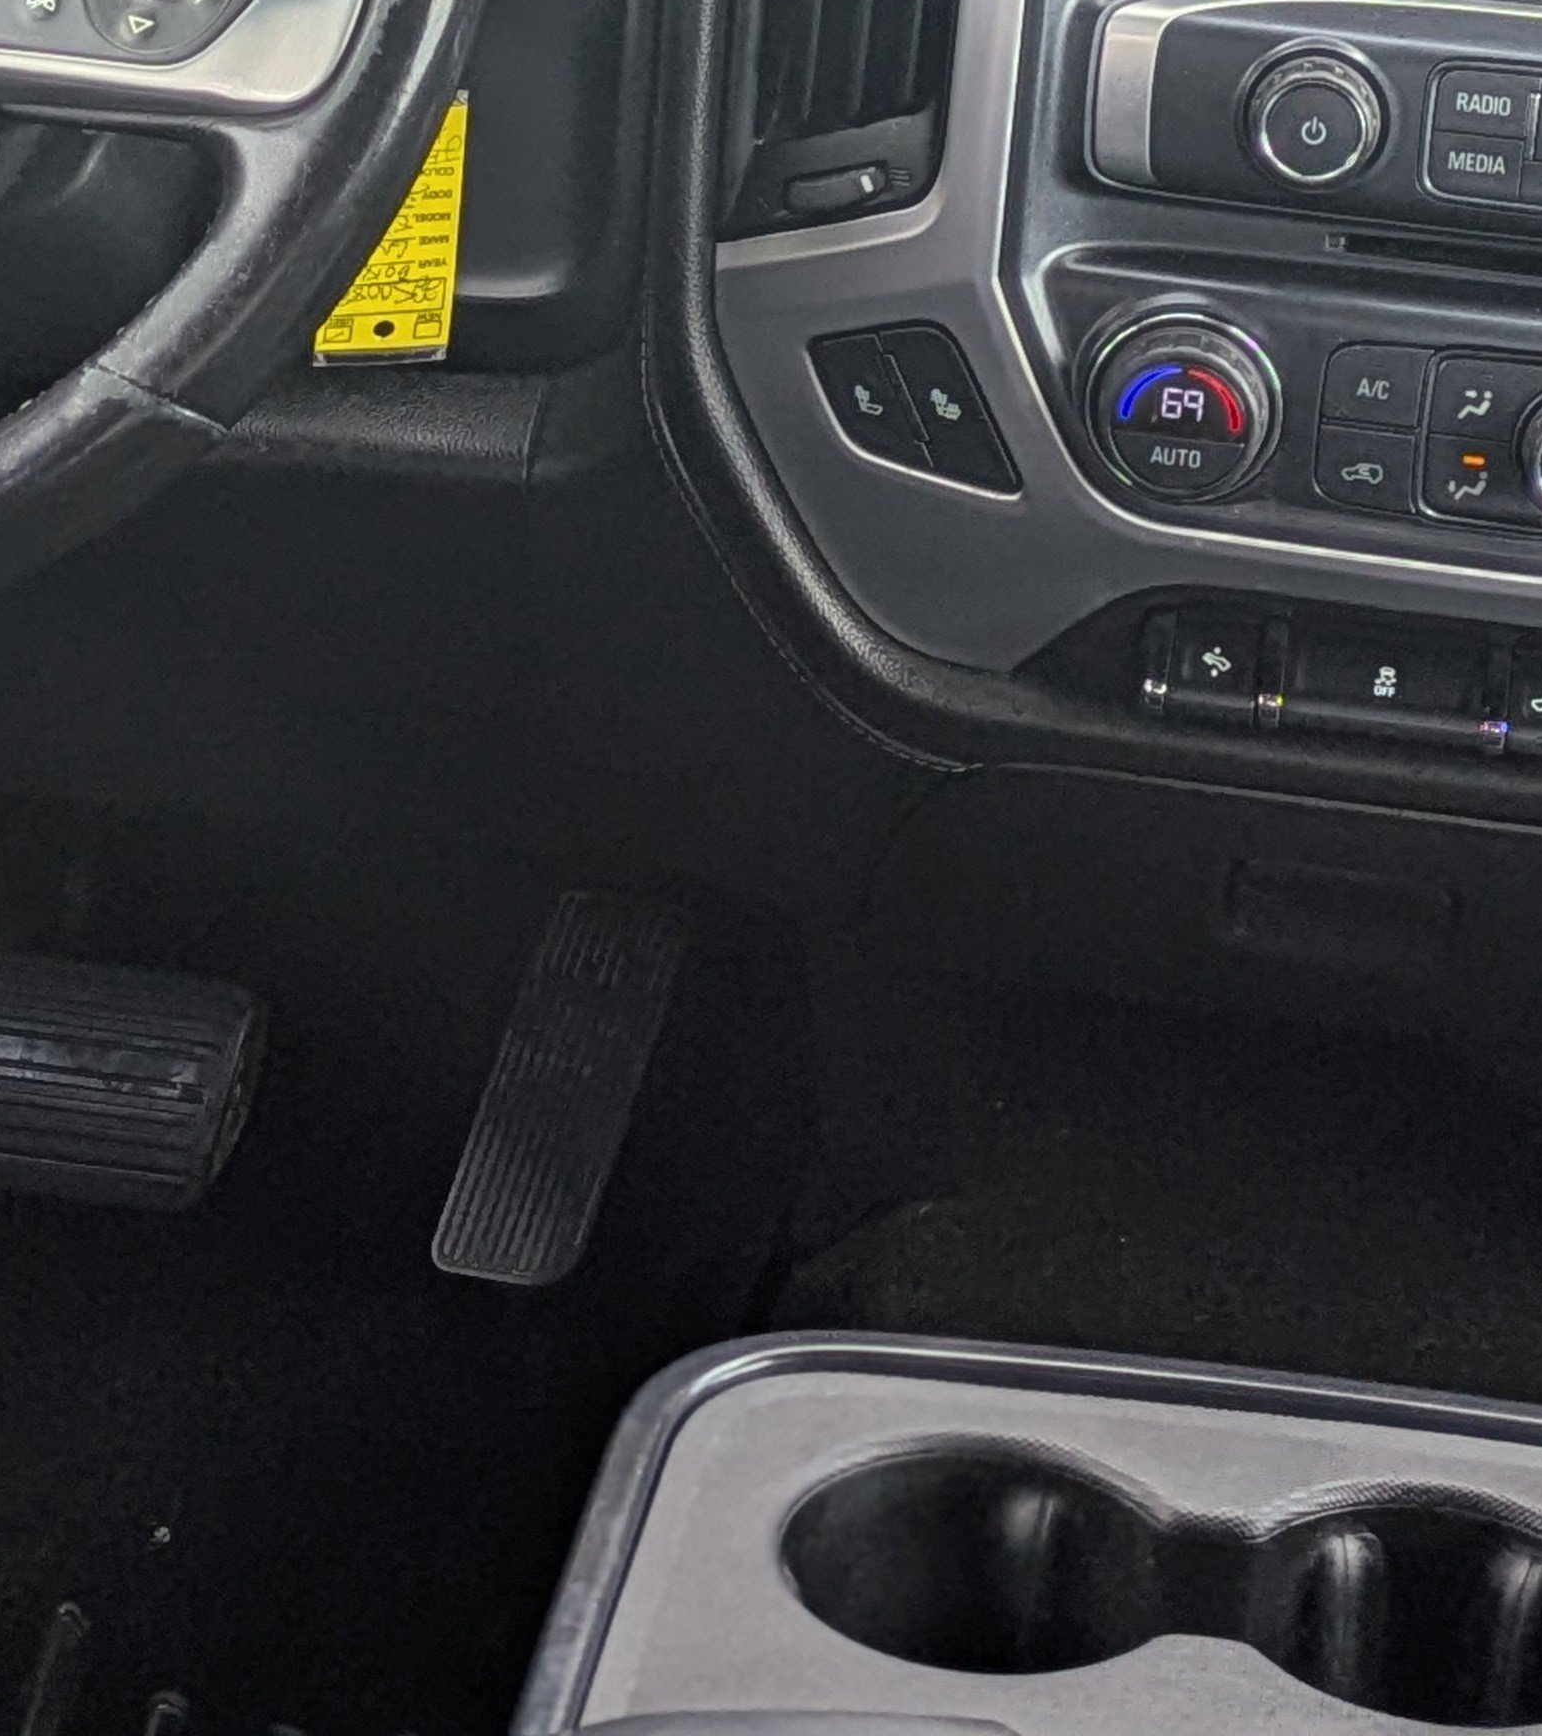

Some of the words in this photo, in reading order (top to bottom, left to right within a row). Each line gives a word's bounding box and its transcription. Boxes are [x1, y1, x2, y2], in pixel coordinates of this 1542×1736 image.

[1455, 91, 1512, 120] RADIO
[1446, 150, 1507, 177] MEDIA
[1356, 377, 1391, 401] A/C
[1161, 387, 1205, 423] 69
[1150, 445, 1202, 470] AUTO
[1373, 684, 1397, 698] OFF
